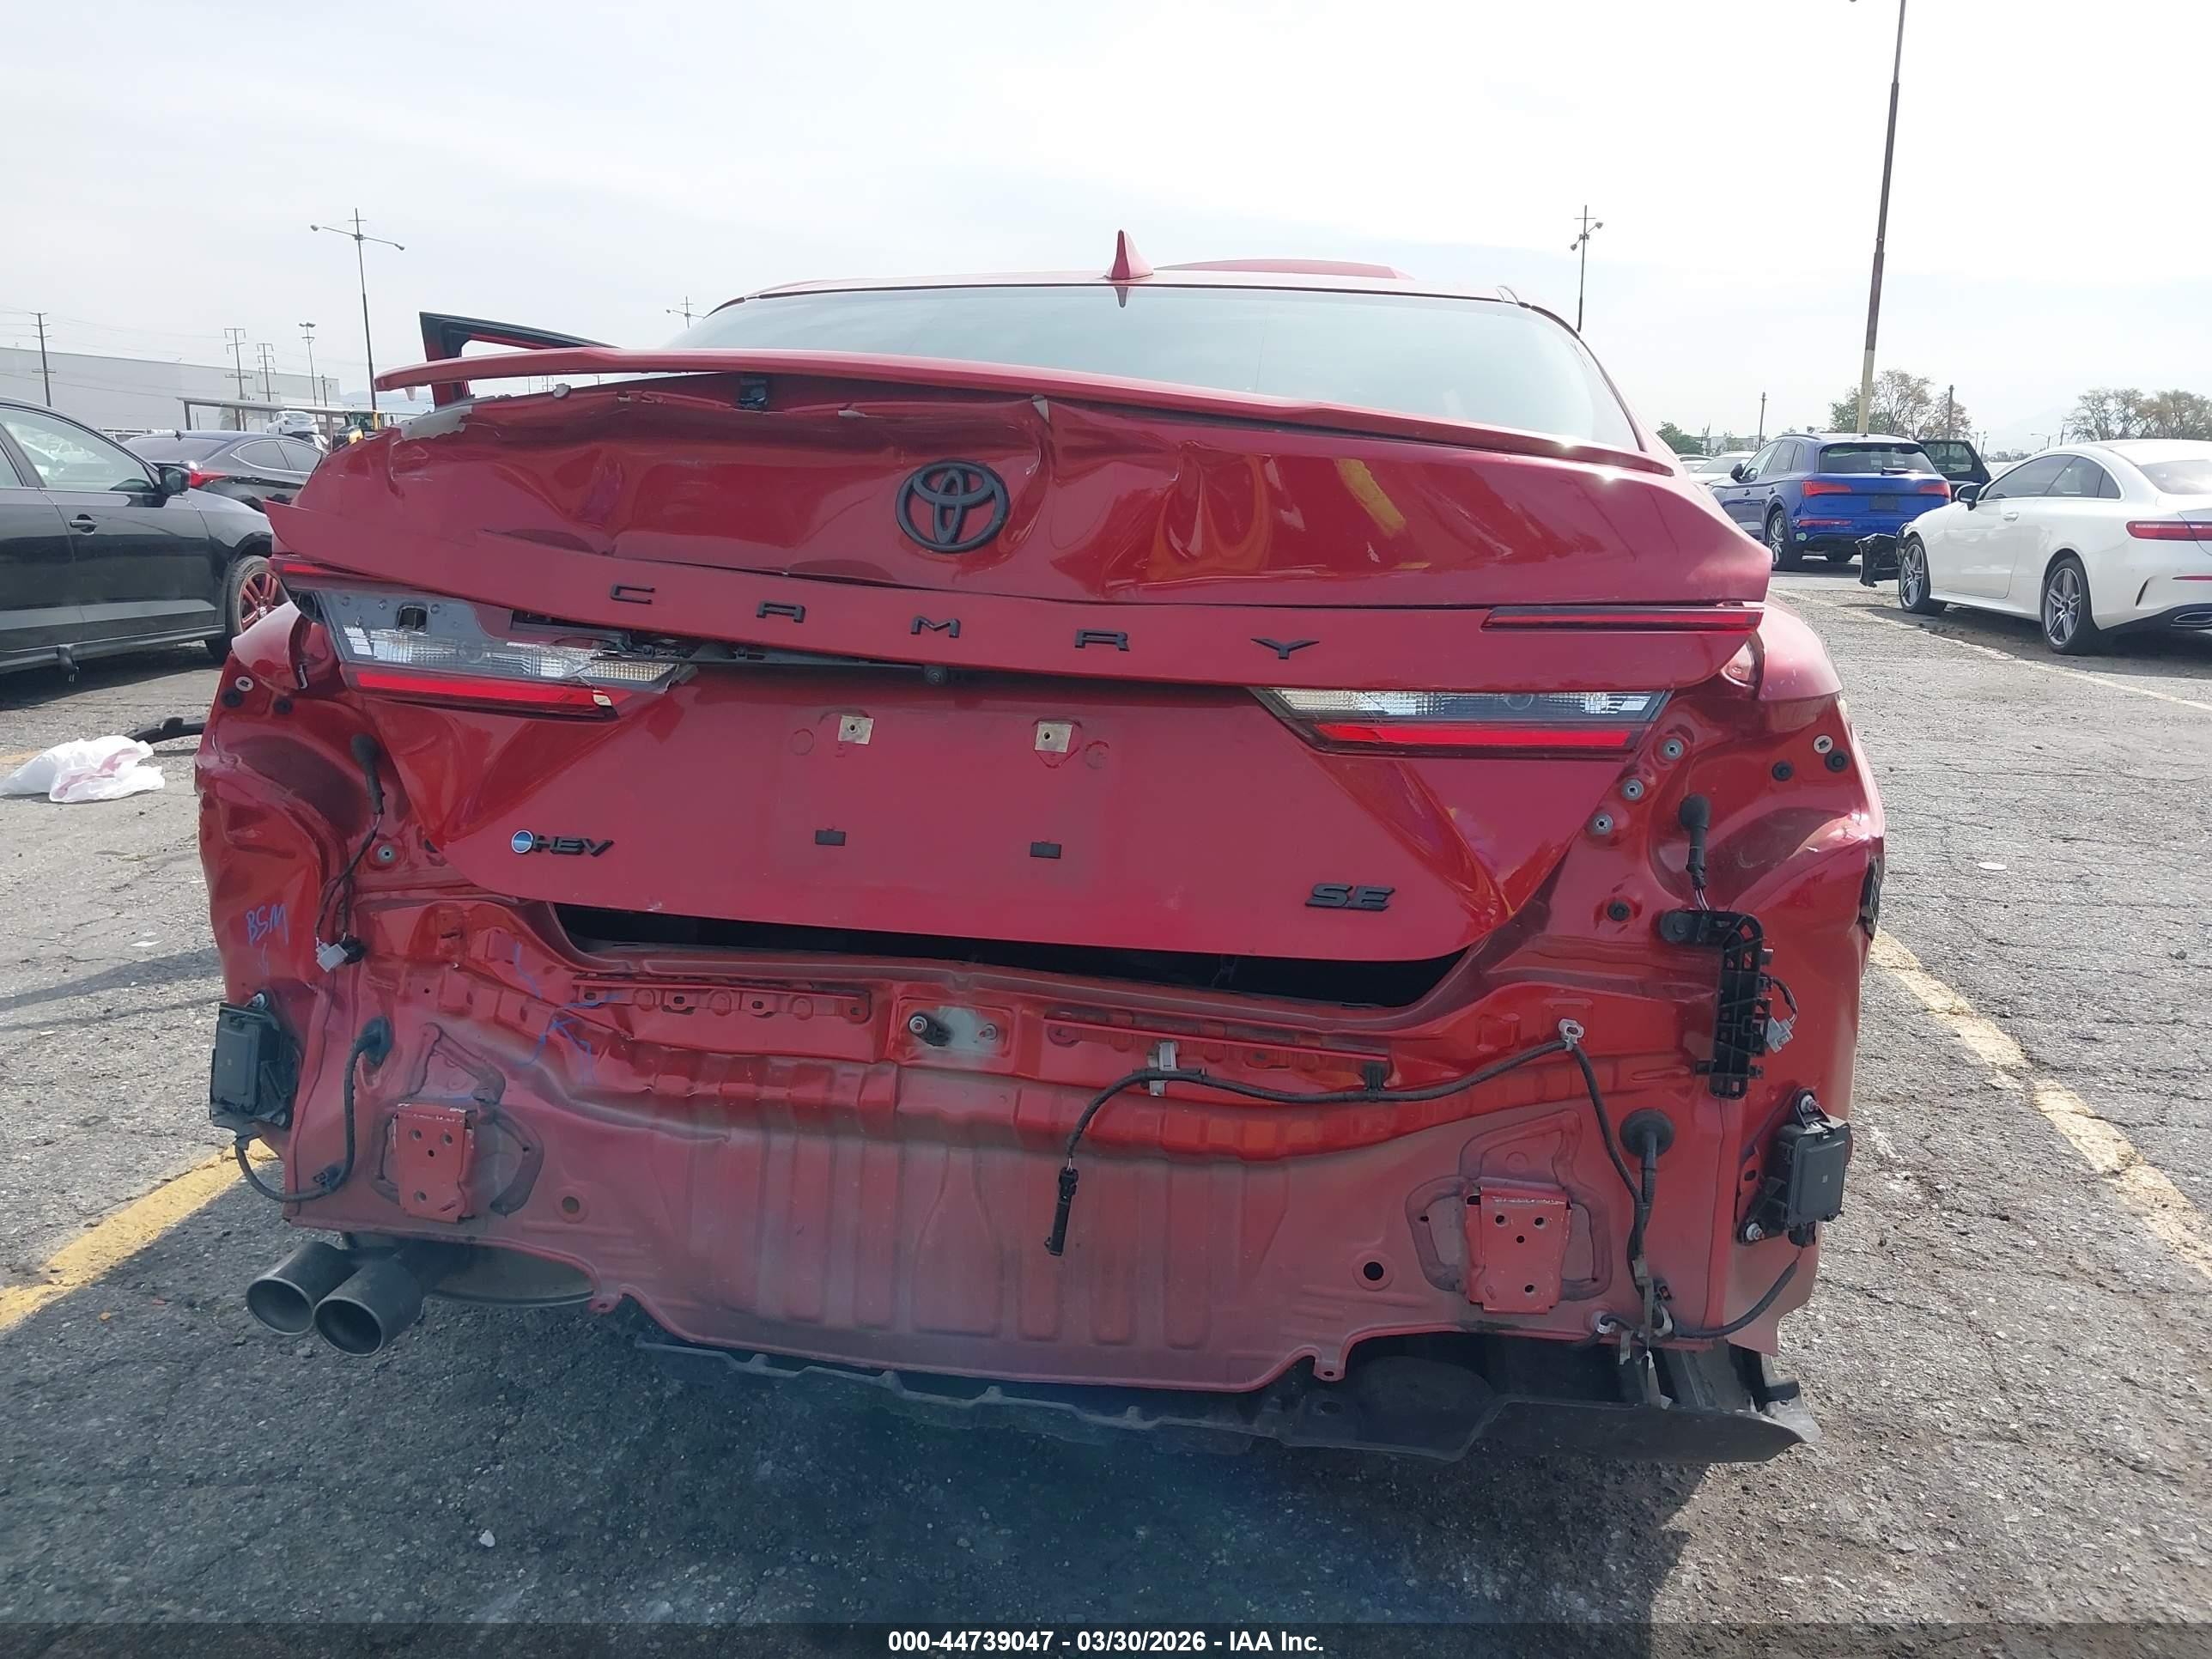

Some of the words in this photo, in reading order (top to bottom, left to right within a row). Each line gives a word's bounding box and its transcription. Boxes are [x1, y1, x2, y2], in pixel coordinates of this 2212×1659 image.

[609, 582, 1321, 661] CAMRY
[532, 834, 614, 858] HEV
[1304, 883, 1395, 913] SE
[246, 902, 289, 947] BSM
